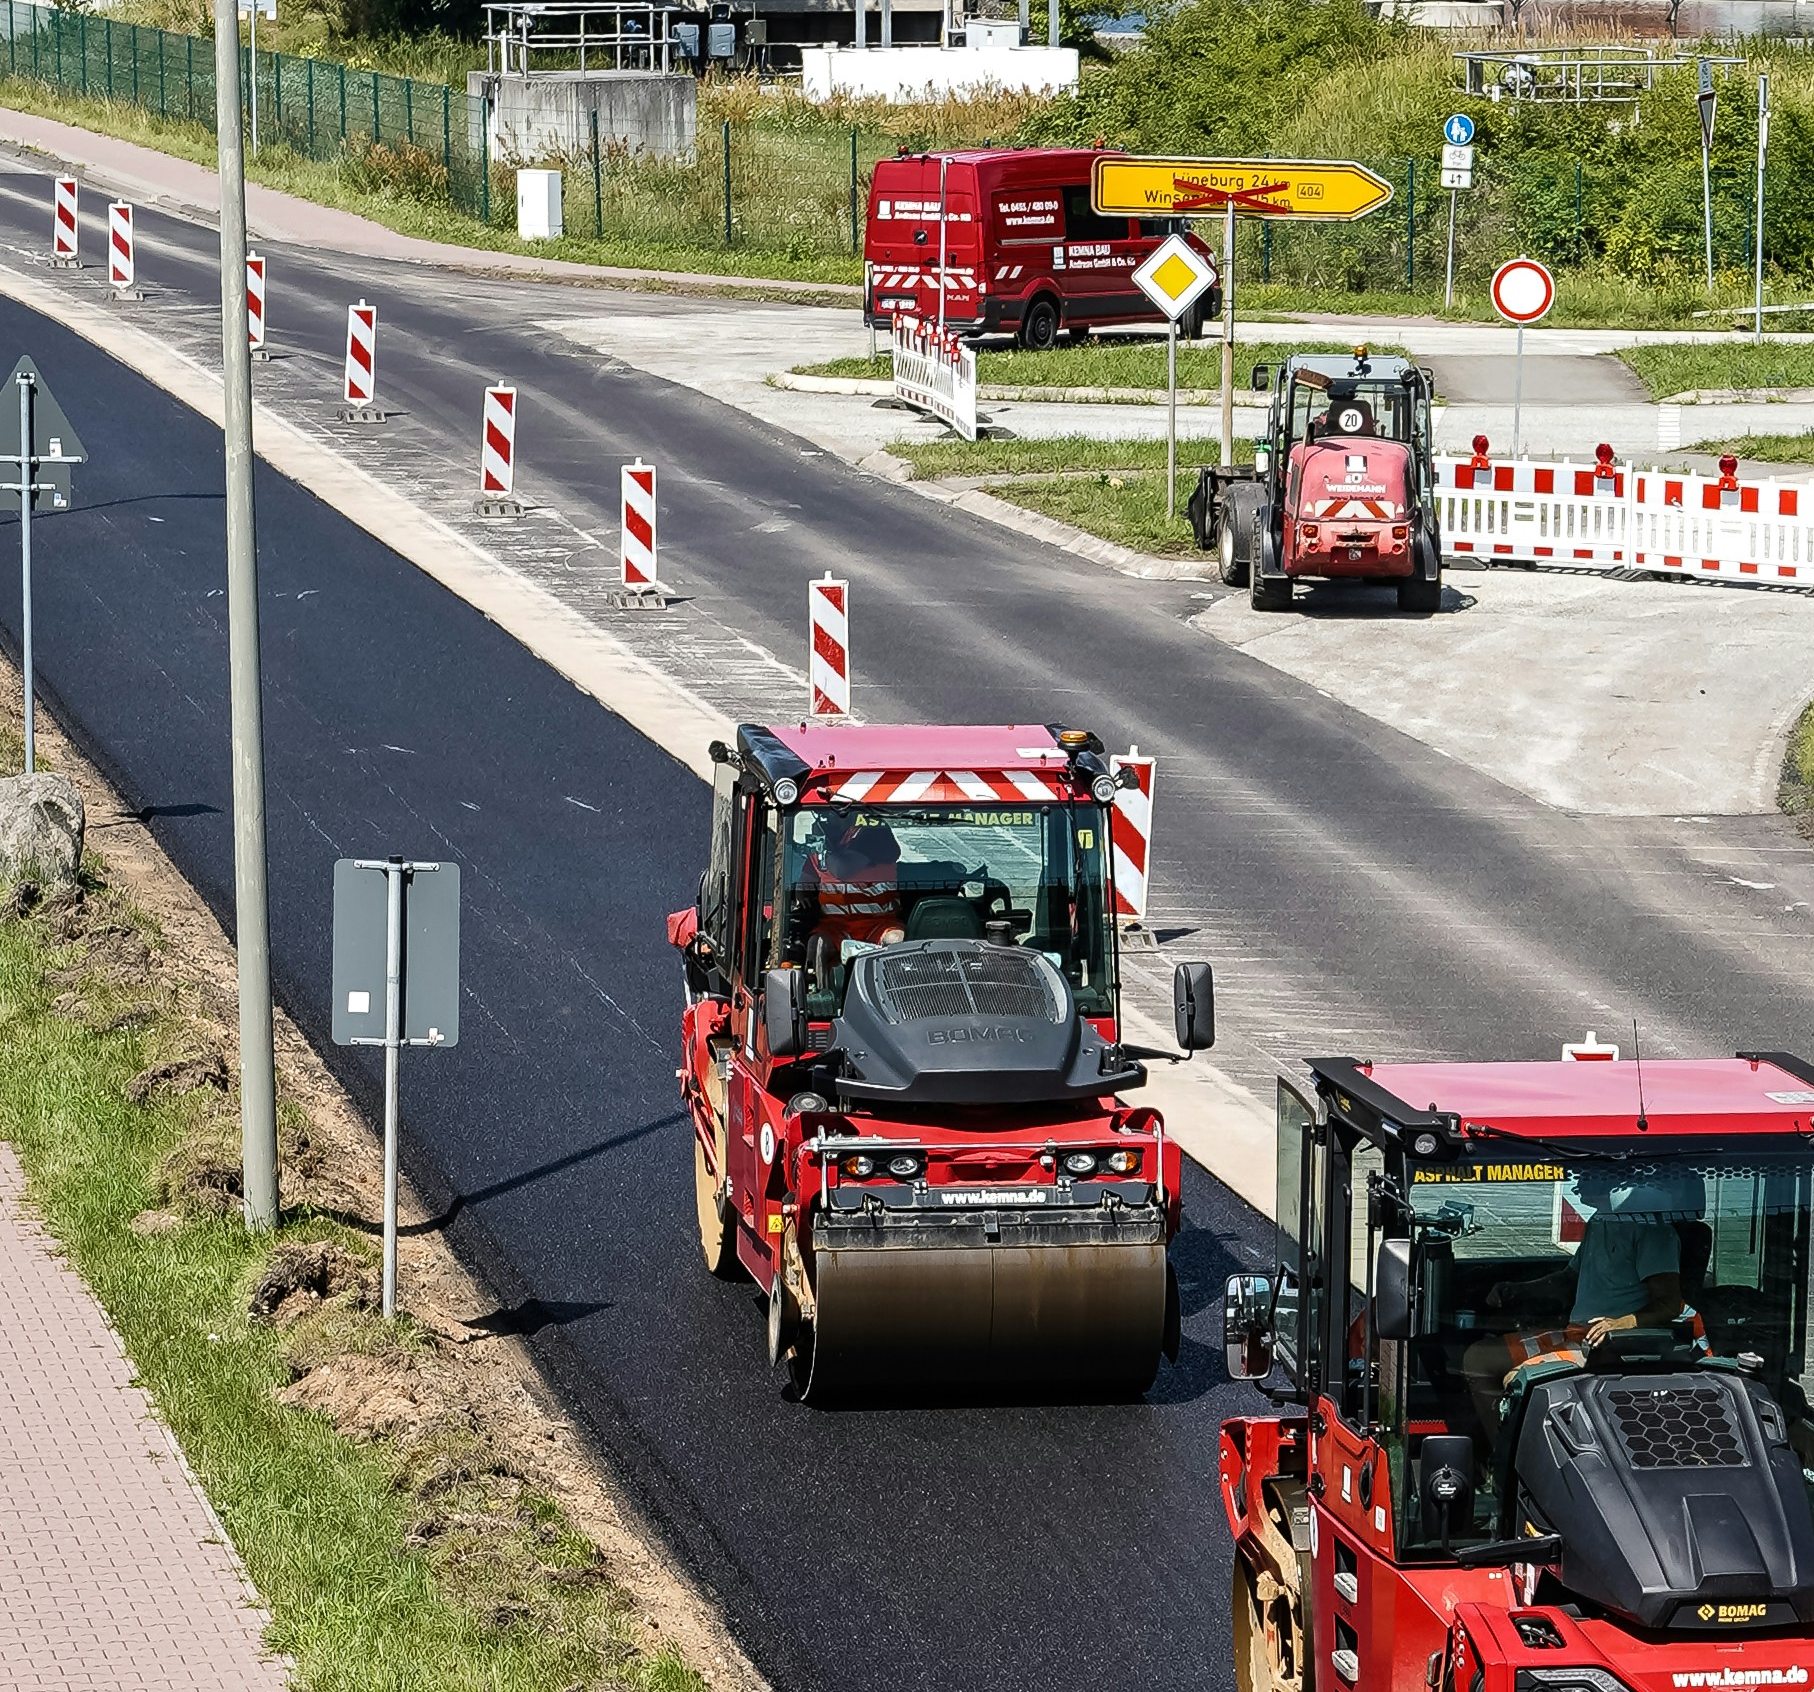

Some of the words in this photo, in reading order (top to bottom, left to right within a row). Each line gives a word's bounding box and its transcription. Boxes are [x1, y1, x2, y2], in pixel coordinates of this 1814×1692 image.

[1252, 175, 1268, 187] 24
[1300, 186, 1320, 197] 404
[1345, 414, 1357, 427] 20
[1326, 484, 1386, 494] WEIDEMANN
[1414, 1165, 1483, 1182] ASPHALT
[1487, 1164, 1565, 1181] MANAGER
[942, 1190, 1046, 1204] www.kemna.de
[1719, 1604, 1766, 1617] BOMAG
[1672, 1665, 1808, 1688] www.kemna.de
